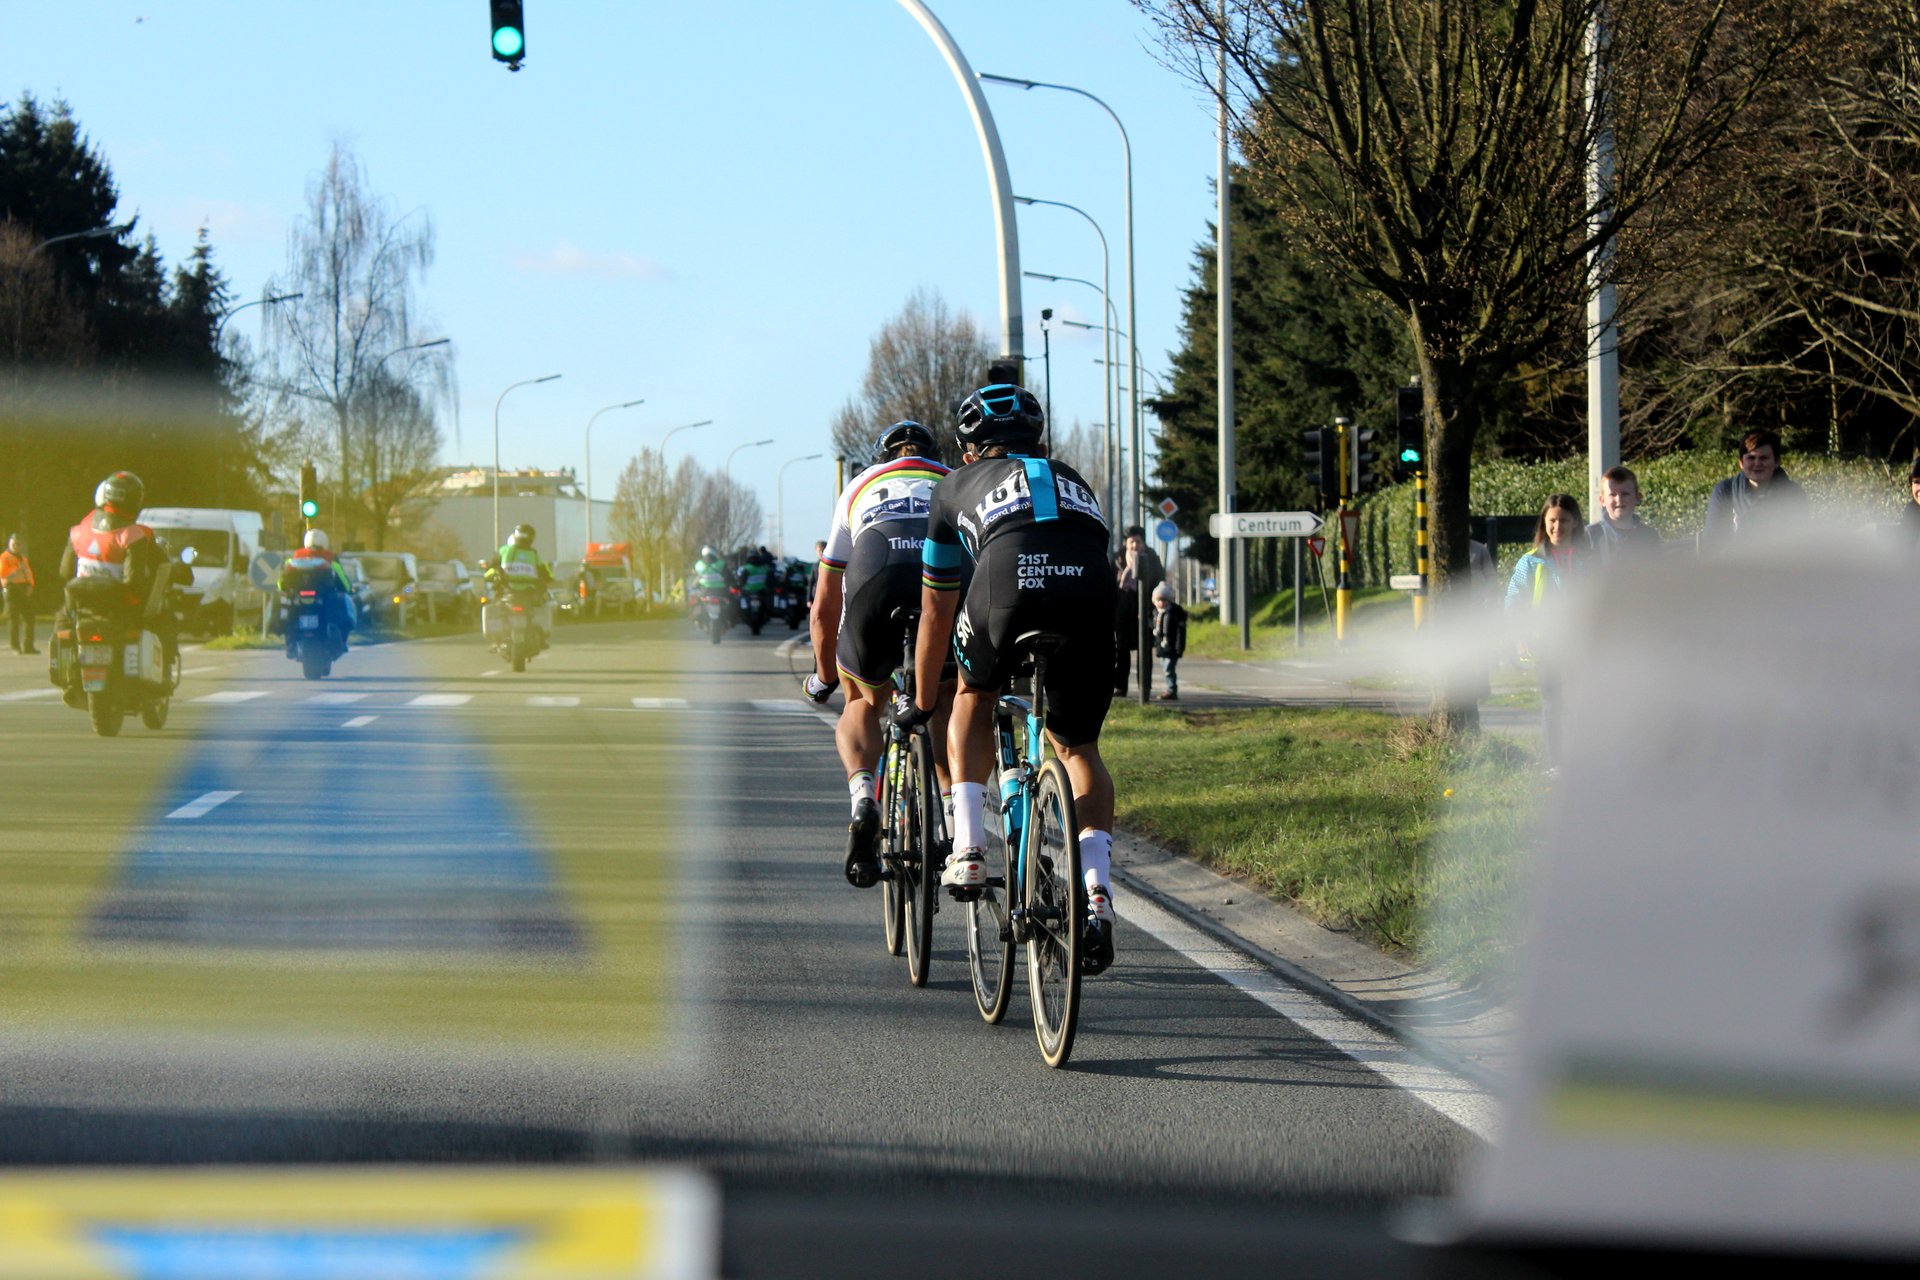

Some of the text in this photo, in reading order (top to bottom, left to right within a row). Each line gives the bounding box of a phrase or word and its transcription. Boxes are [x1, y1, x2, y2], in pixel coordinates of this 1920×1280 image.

[1238, 518, 1302, 532] Centrum
[1017, 553, 1049, 565] 21ST
[1017, 565, 1084, 577] CENTURY
[1017, 577, 1045, 590] FOX
